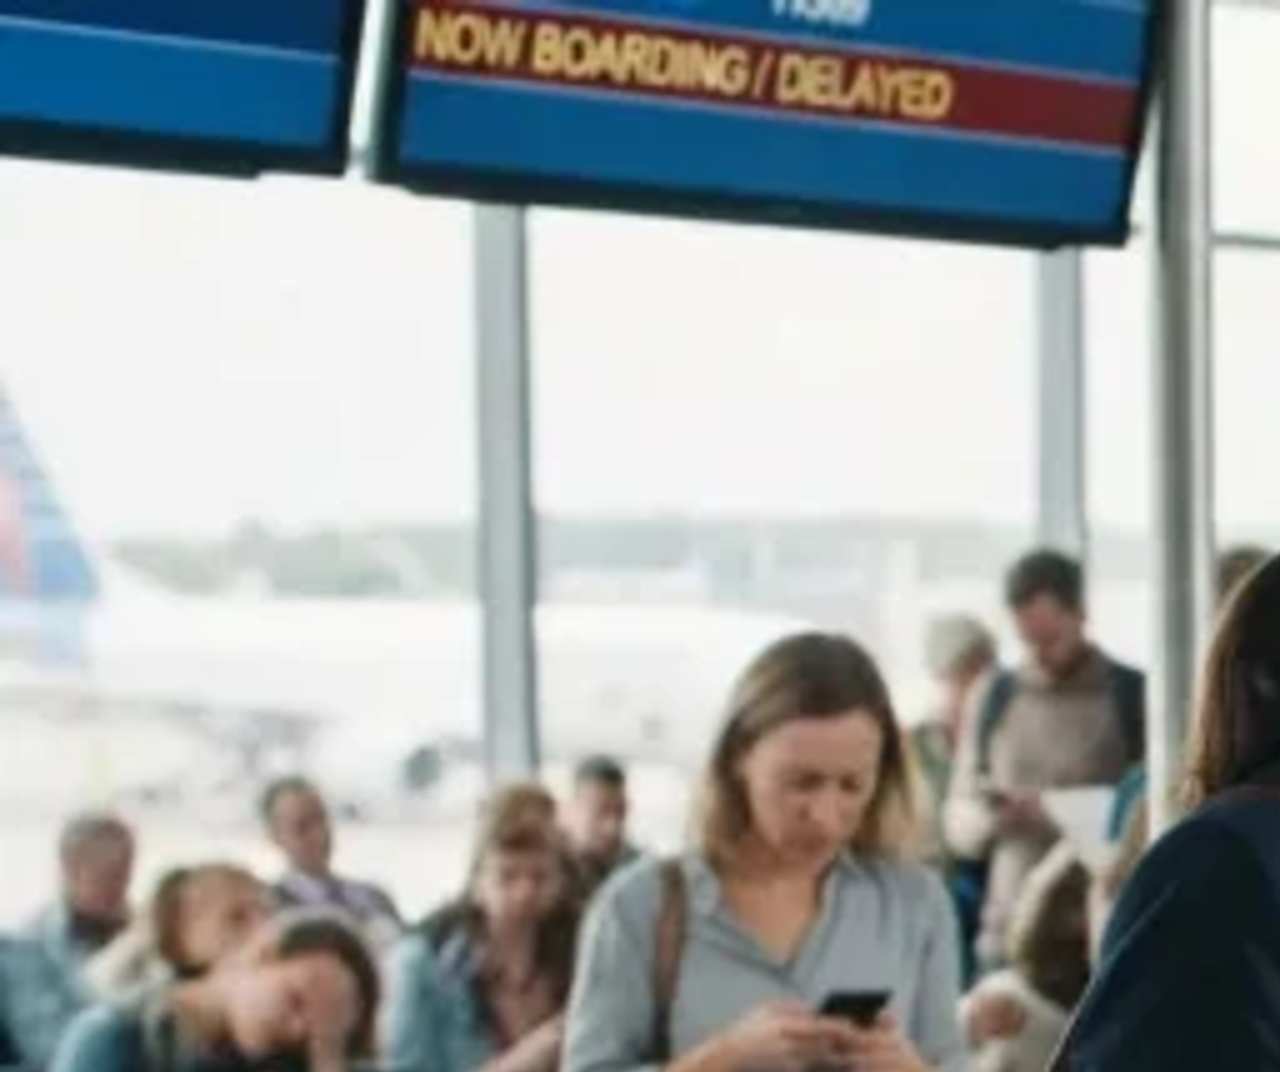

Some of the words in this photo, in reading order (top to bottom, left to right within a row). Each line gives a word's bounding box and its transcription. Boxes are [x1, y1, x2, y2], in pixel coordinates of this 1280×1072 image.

[415, 9, 526, 67] NOW
[533, 21, 748, 93] BOARDING
[754, 50, 774, 97] /
[776, 53, 953, 118] DELAYED
